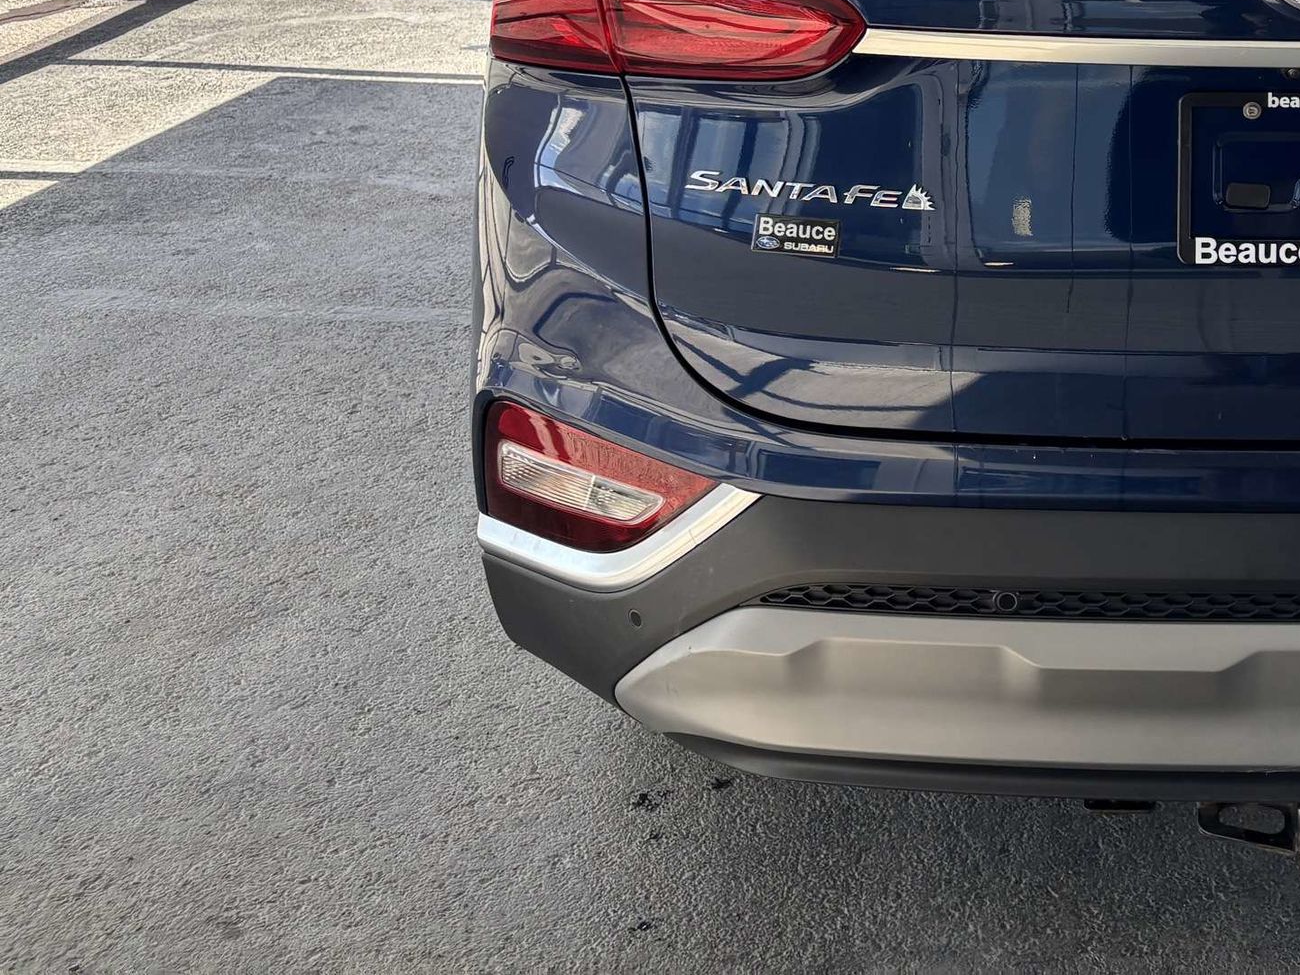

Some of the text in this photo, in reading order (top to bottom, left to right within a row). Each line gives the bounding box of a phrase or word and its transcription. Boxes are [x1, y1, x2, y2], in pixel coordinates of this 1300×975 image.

[684, 170, 903, 208] SANTA FE
[758, 216, 836, 241] Beauce
[783, 241, 834, 254] SUBARU
